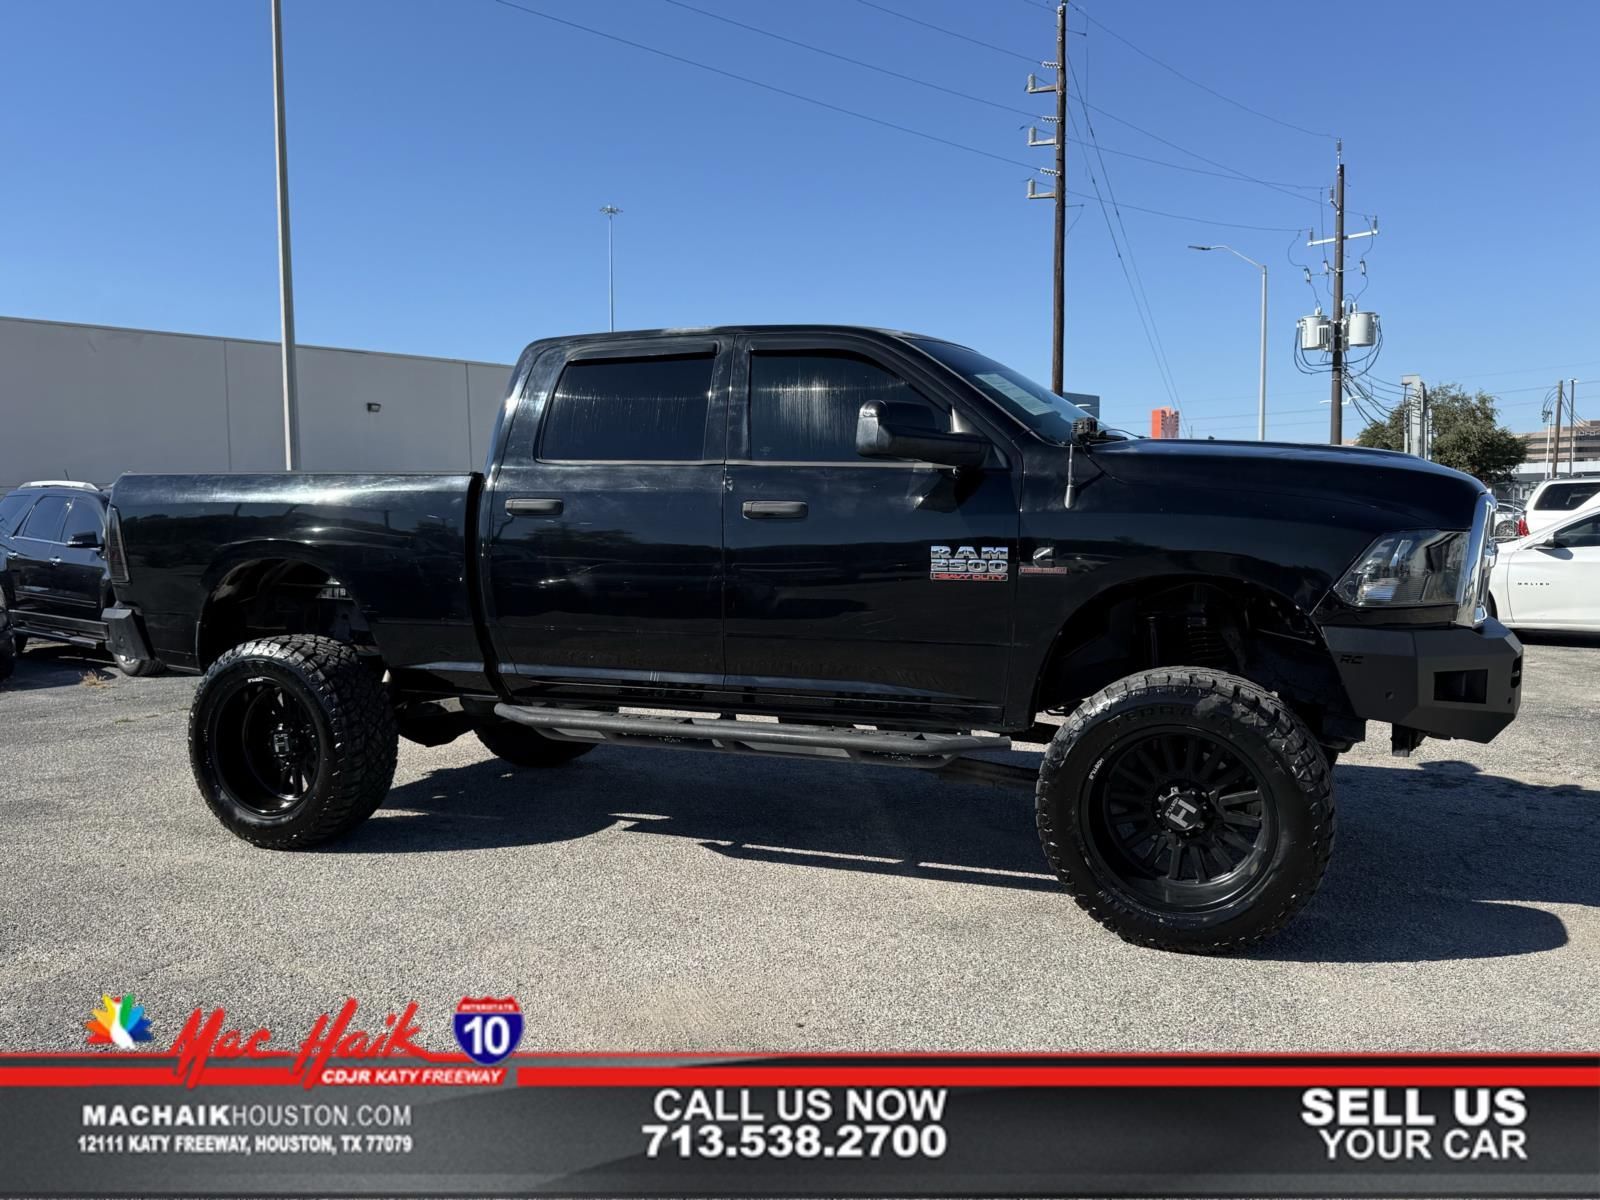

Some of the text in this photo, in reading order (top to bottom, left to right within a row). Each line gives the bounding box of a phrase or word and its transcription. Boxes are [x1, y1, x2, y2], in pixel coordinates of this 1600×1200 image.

[930, 545, 1008, 559] RAM
[930, 559, 1008, 573] 2500
[972, 573, 1005, 581] DUTY
[1340, 654, 1364, 664] RC
